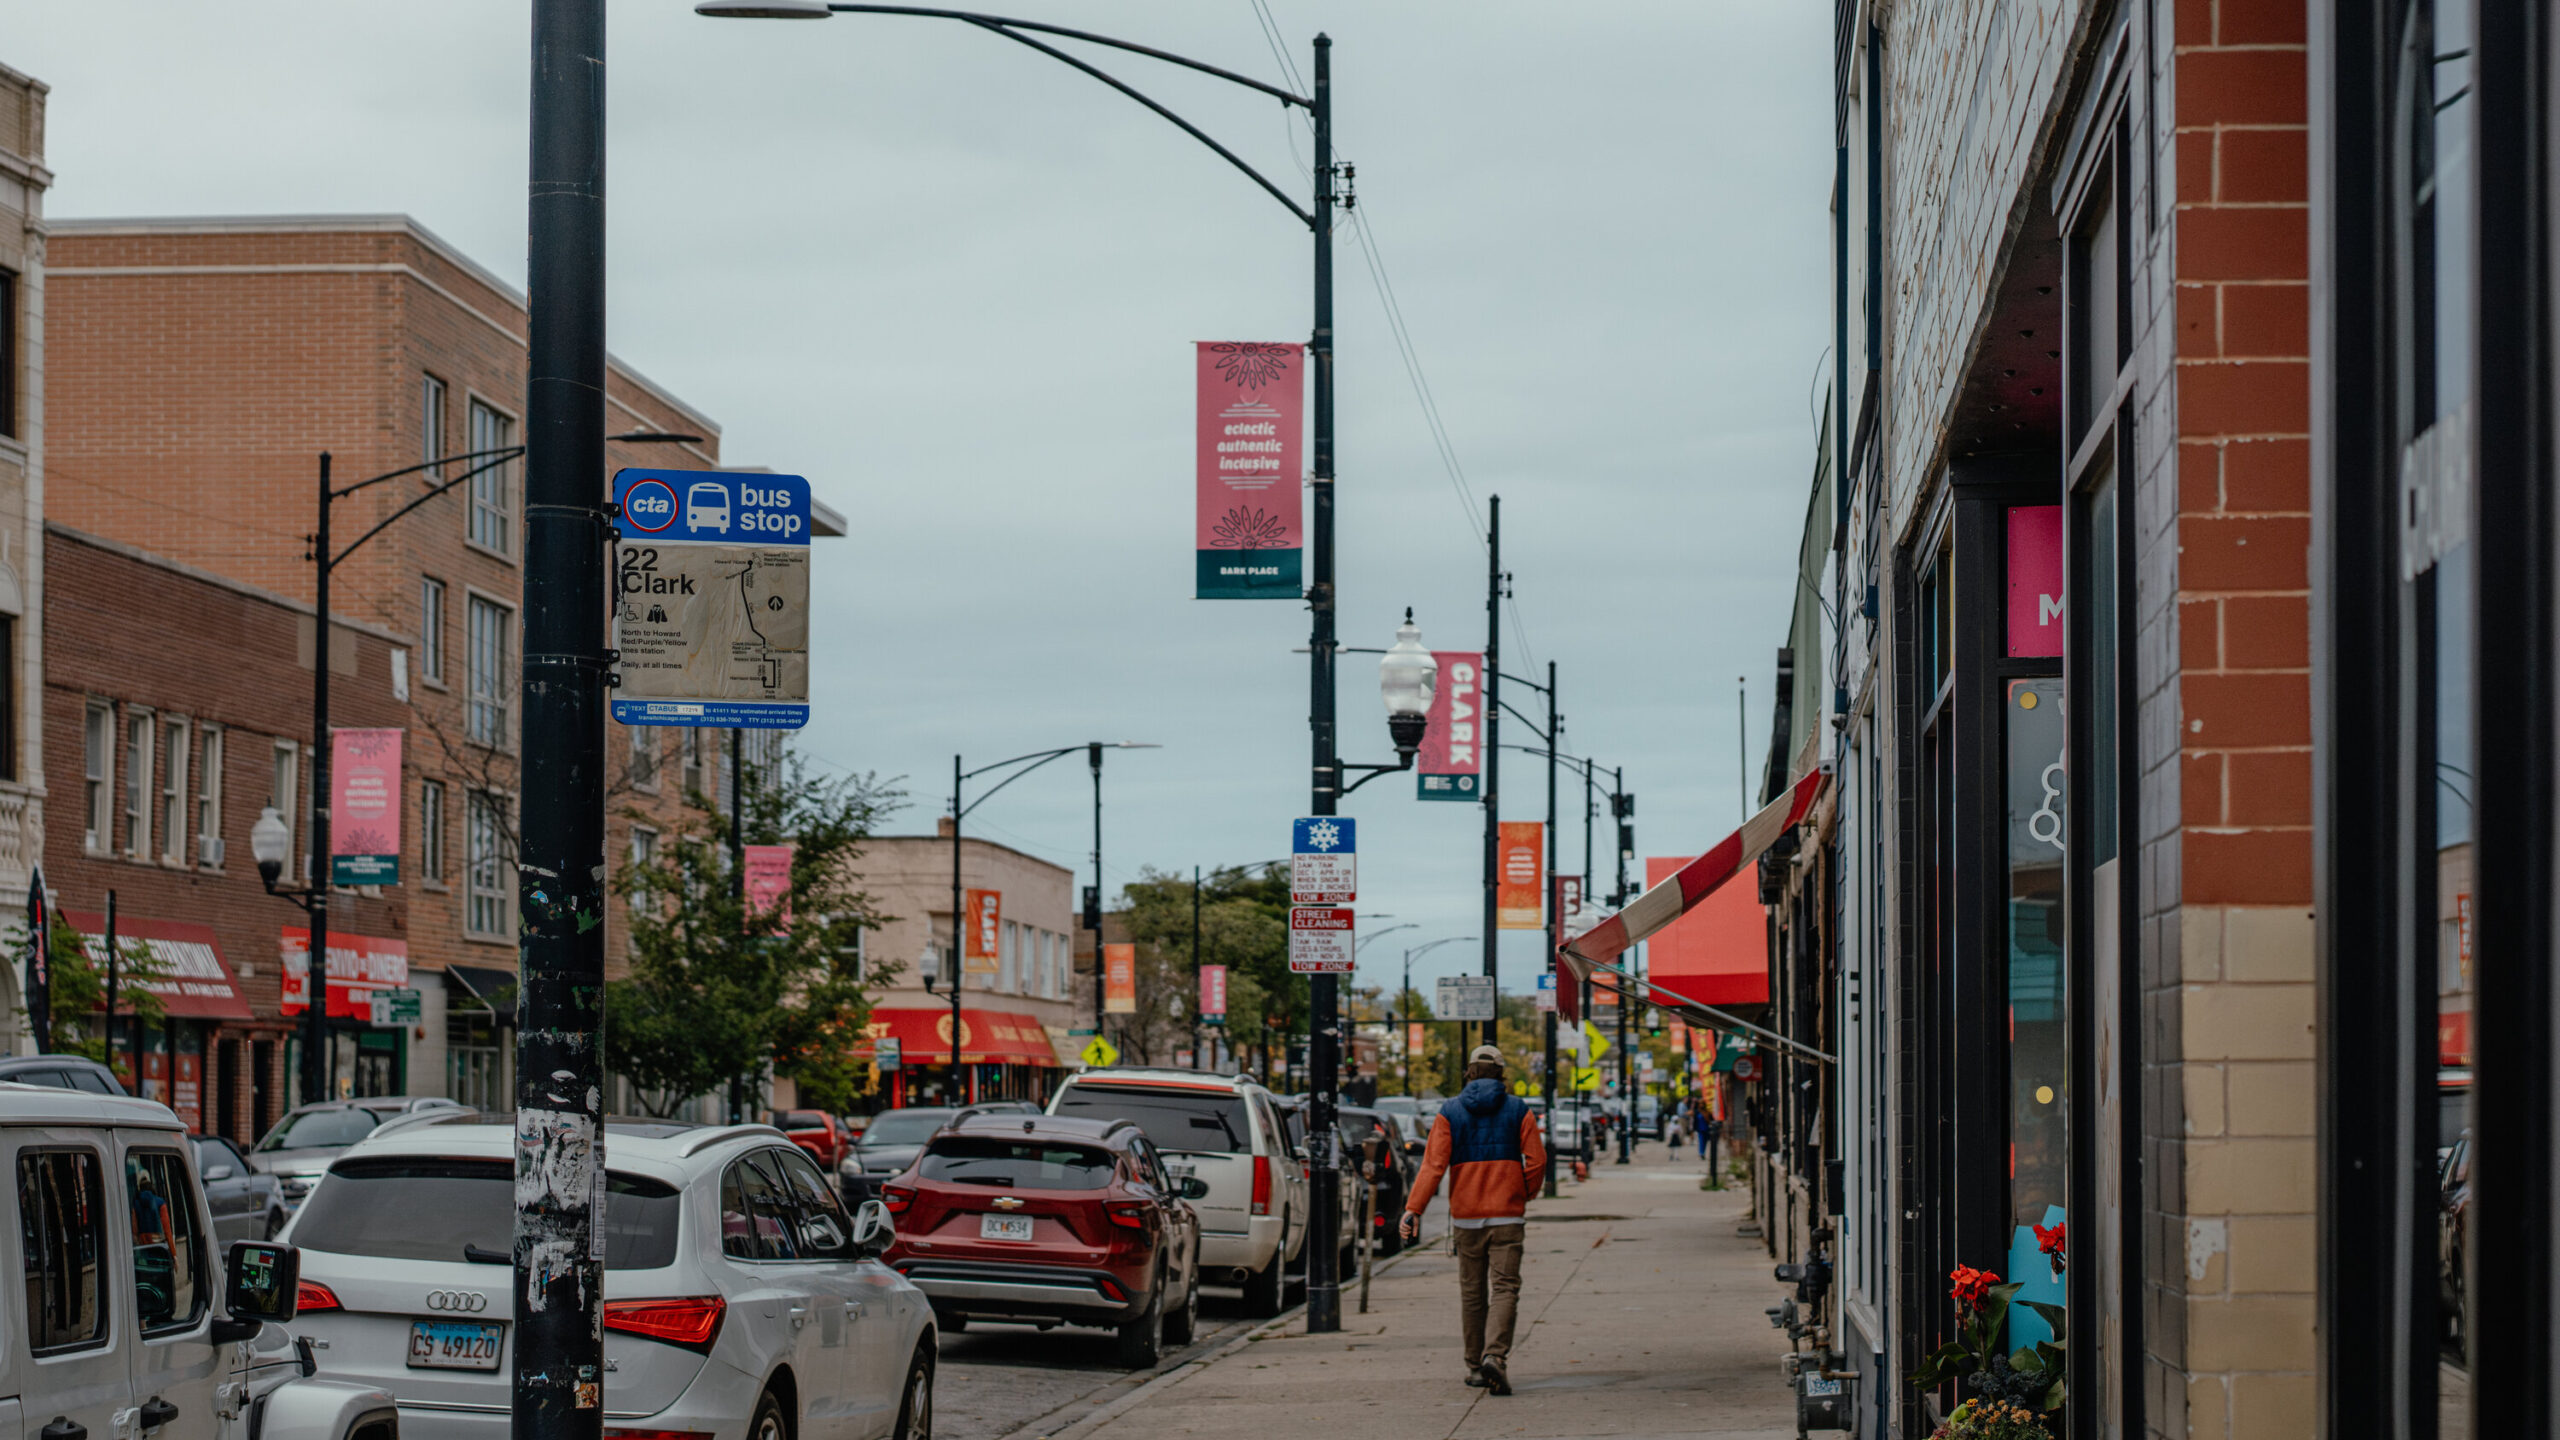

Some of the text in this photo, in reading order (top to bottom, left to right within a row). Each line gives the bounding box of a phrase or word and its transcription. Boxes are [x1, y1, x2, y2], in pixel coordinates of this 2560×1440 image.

[1224, 422, 1276, 436] eclectic
[1217, 439, 1282, 452] authentic
[1220, 456, 1280, 470] inclusive
[741, 483, 792, 507] bus
[633, 495, 669, 514] cta
[740, 508, 801, 538] stop
[622, 547, 658, 572] 22
[1220, 566, 1279, 576] BARK PLACE
[622, 571, 695, 595] Clark
[621, 638, 688, 646] Red/Purple/Yellow
[621, 661, 641, 669] Daily,
[1450, 662, 1474, 766] CLARK
[1296, 893, 1350, 902] TOW ZONE
[1295, 910, 1332, 918] STREET
[981, 895, 998, 954] CLARK
[1295, 919, 1348, 928] CLEANING
[368, 952, 408, 983] DINERO
[1296, 962, 1349, 970] TOW ZONE
[412, 1334, 495, 1358] CS 49120
